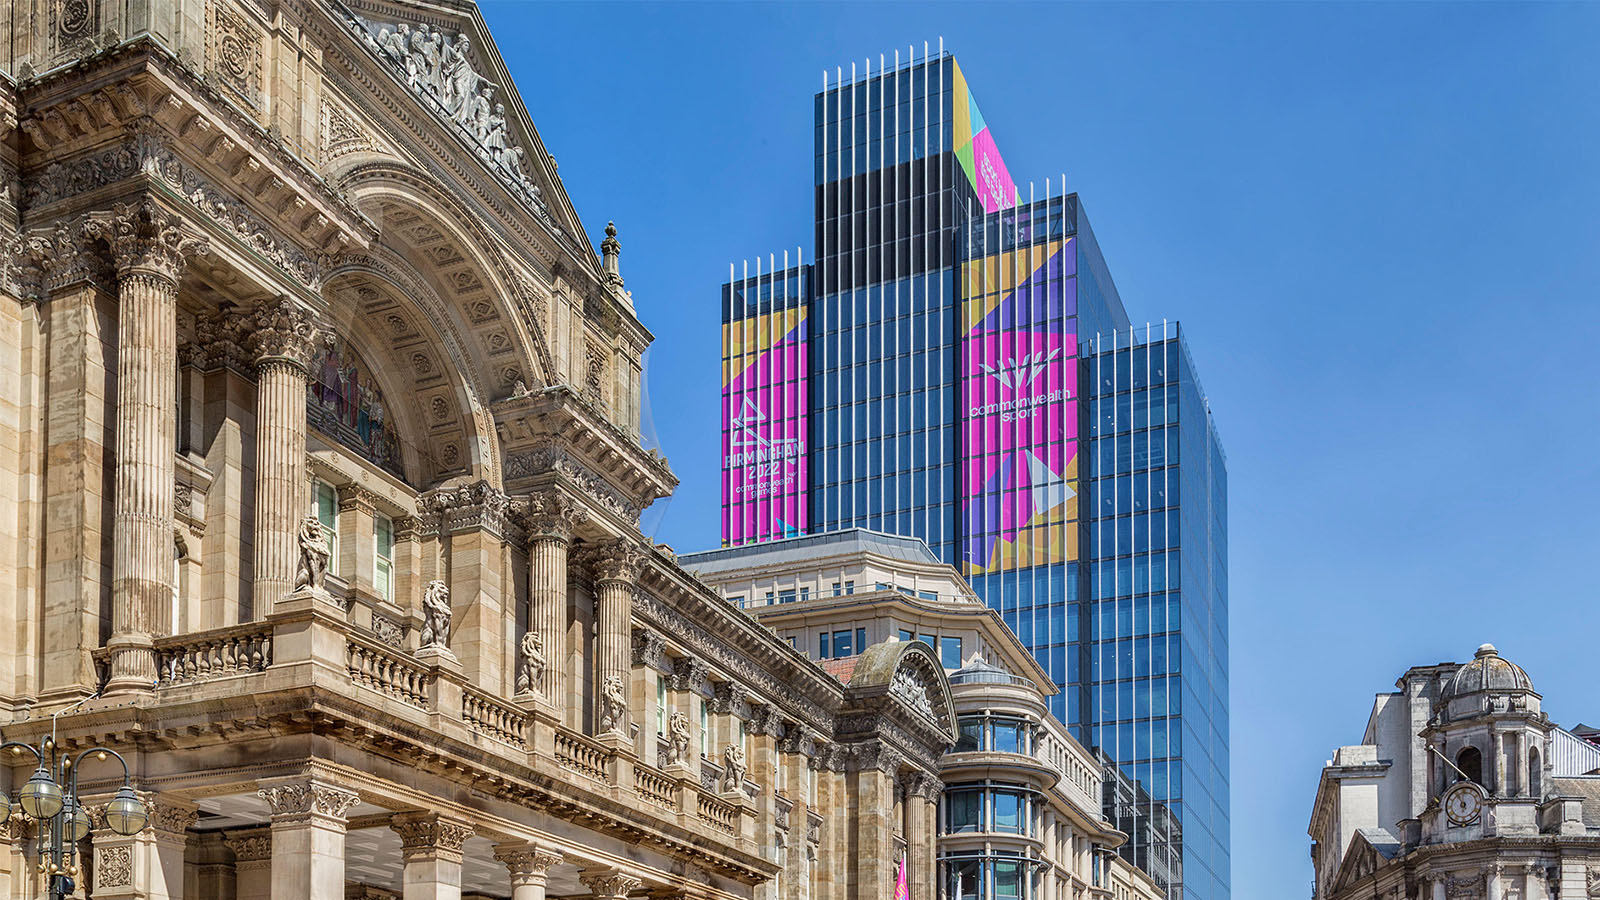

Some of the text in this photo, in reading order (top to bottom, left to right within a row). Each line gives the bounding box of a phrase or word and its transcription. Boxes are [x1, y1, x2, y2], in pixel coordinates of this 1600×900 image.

[970, 389, 1070, 417] commonwealth
[1002, 407, 1038, 422] sport
[725, 441, 804, 468] BIRMINGHAM
[749, 461, 780, 480] 2022
[735, 476, 793, 493] commonweah
[750, 486, 777, 499] gmes
